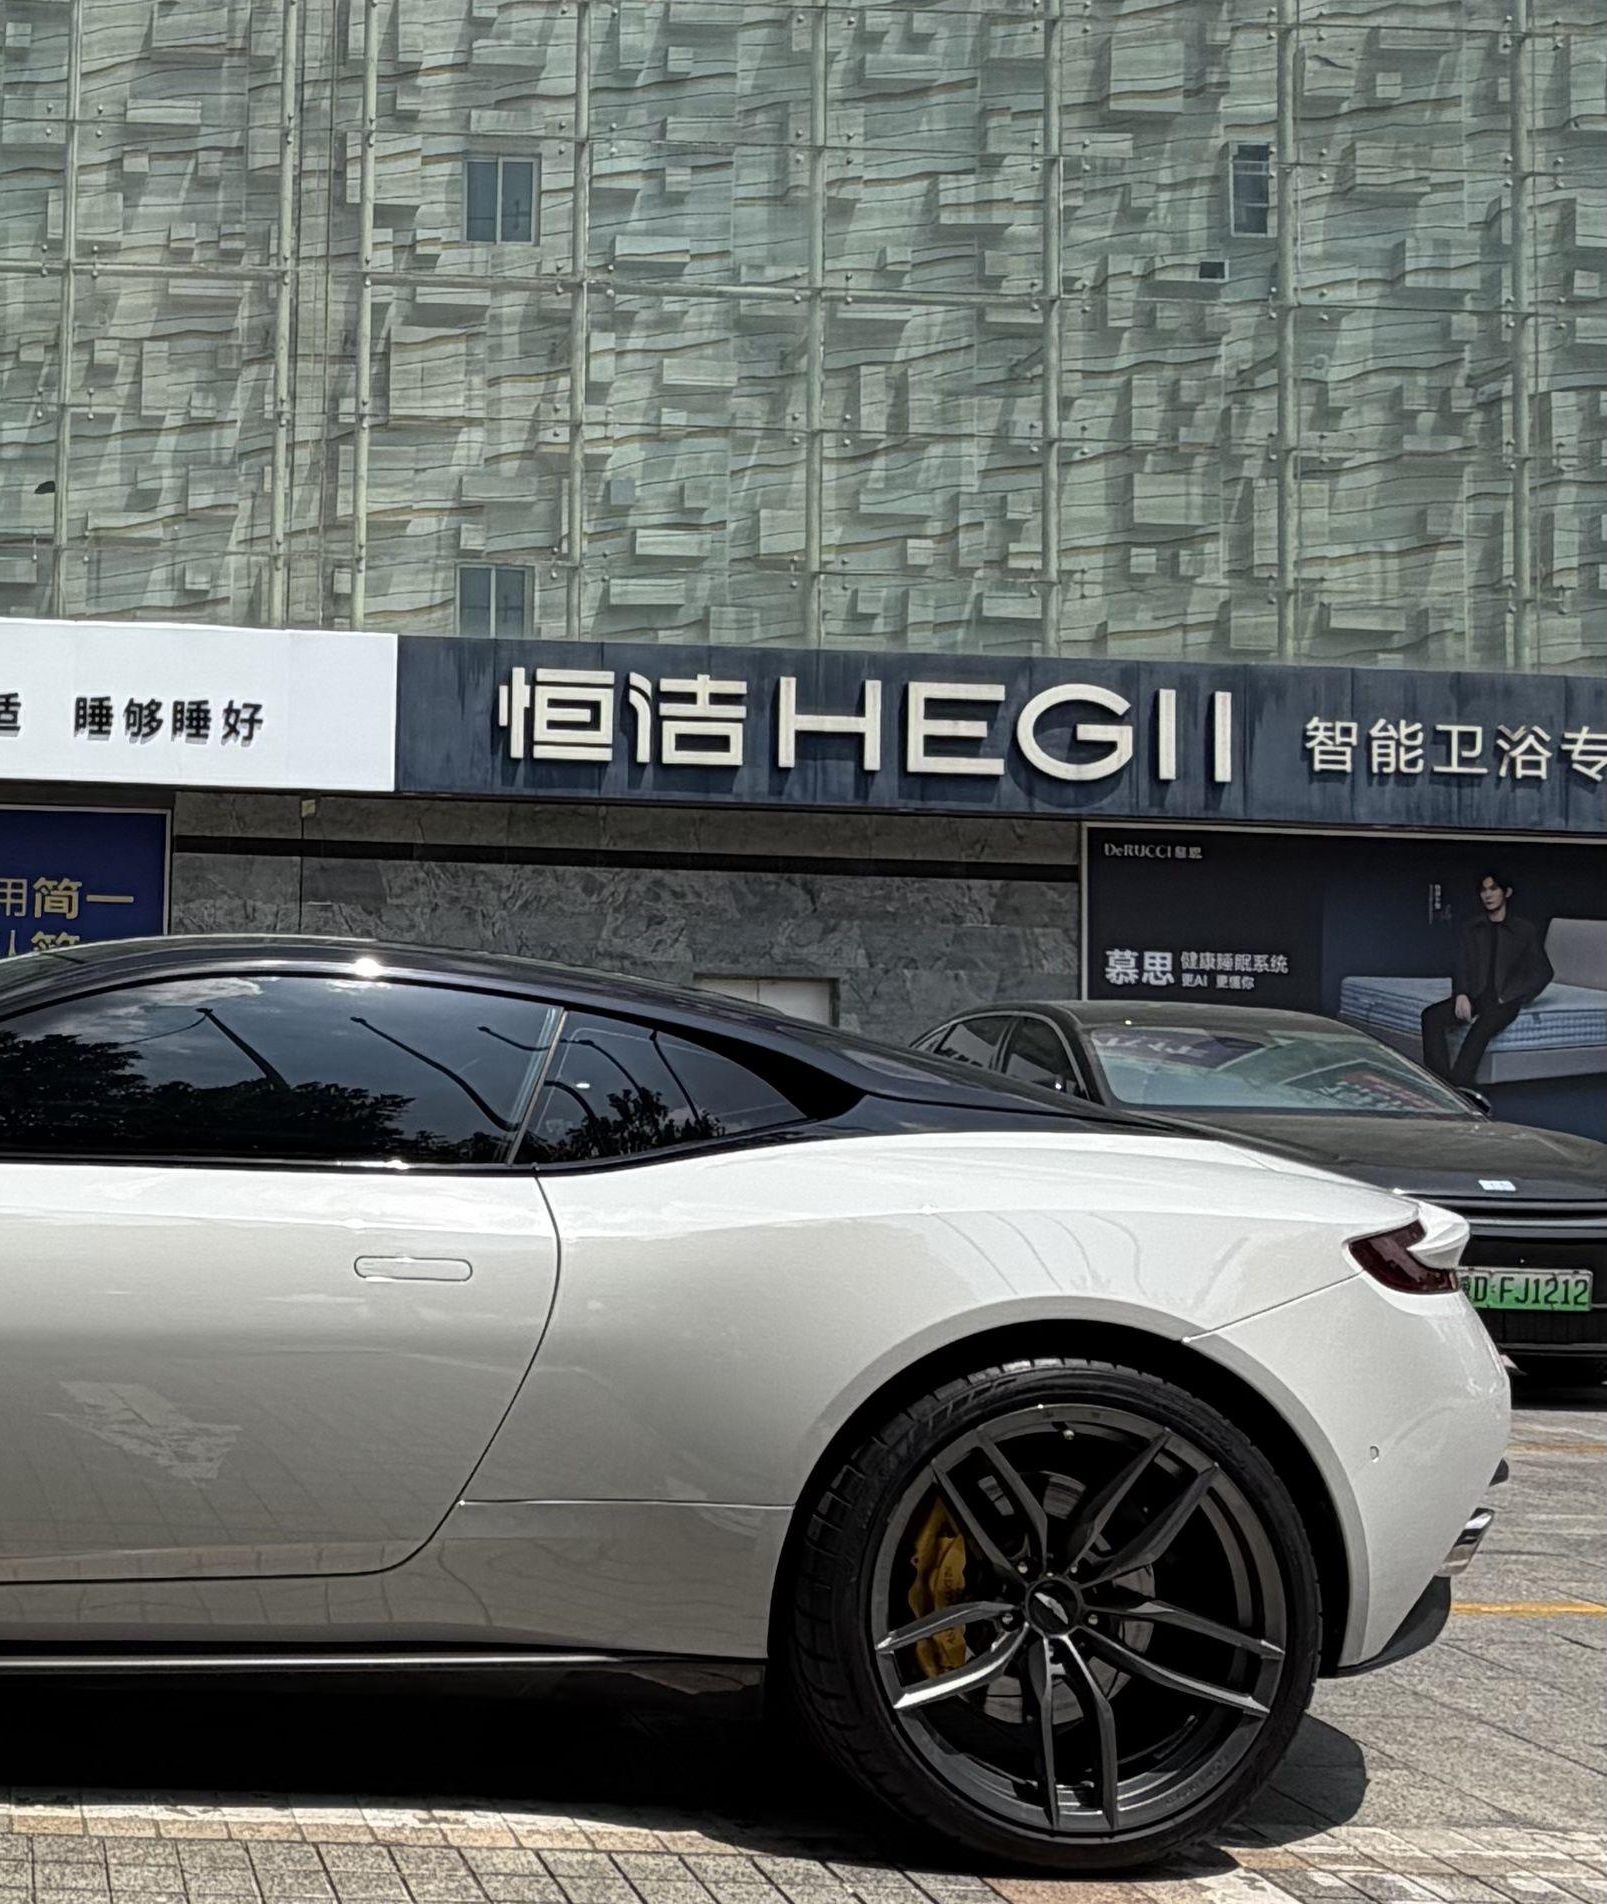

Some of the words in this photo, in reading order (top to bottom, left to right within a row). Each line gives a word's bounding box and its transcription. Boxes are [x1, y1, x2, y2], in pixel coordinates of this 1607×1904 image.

[75, 696, 263, 742] 睡够睡好
[1305, 715, 1607, 782] 智能卫浴专
[1105, 949, 1175, 986] 慕思
